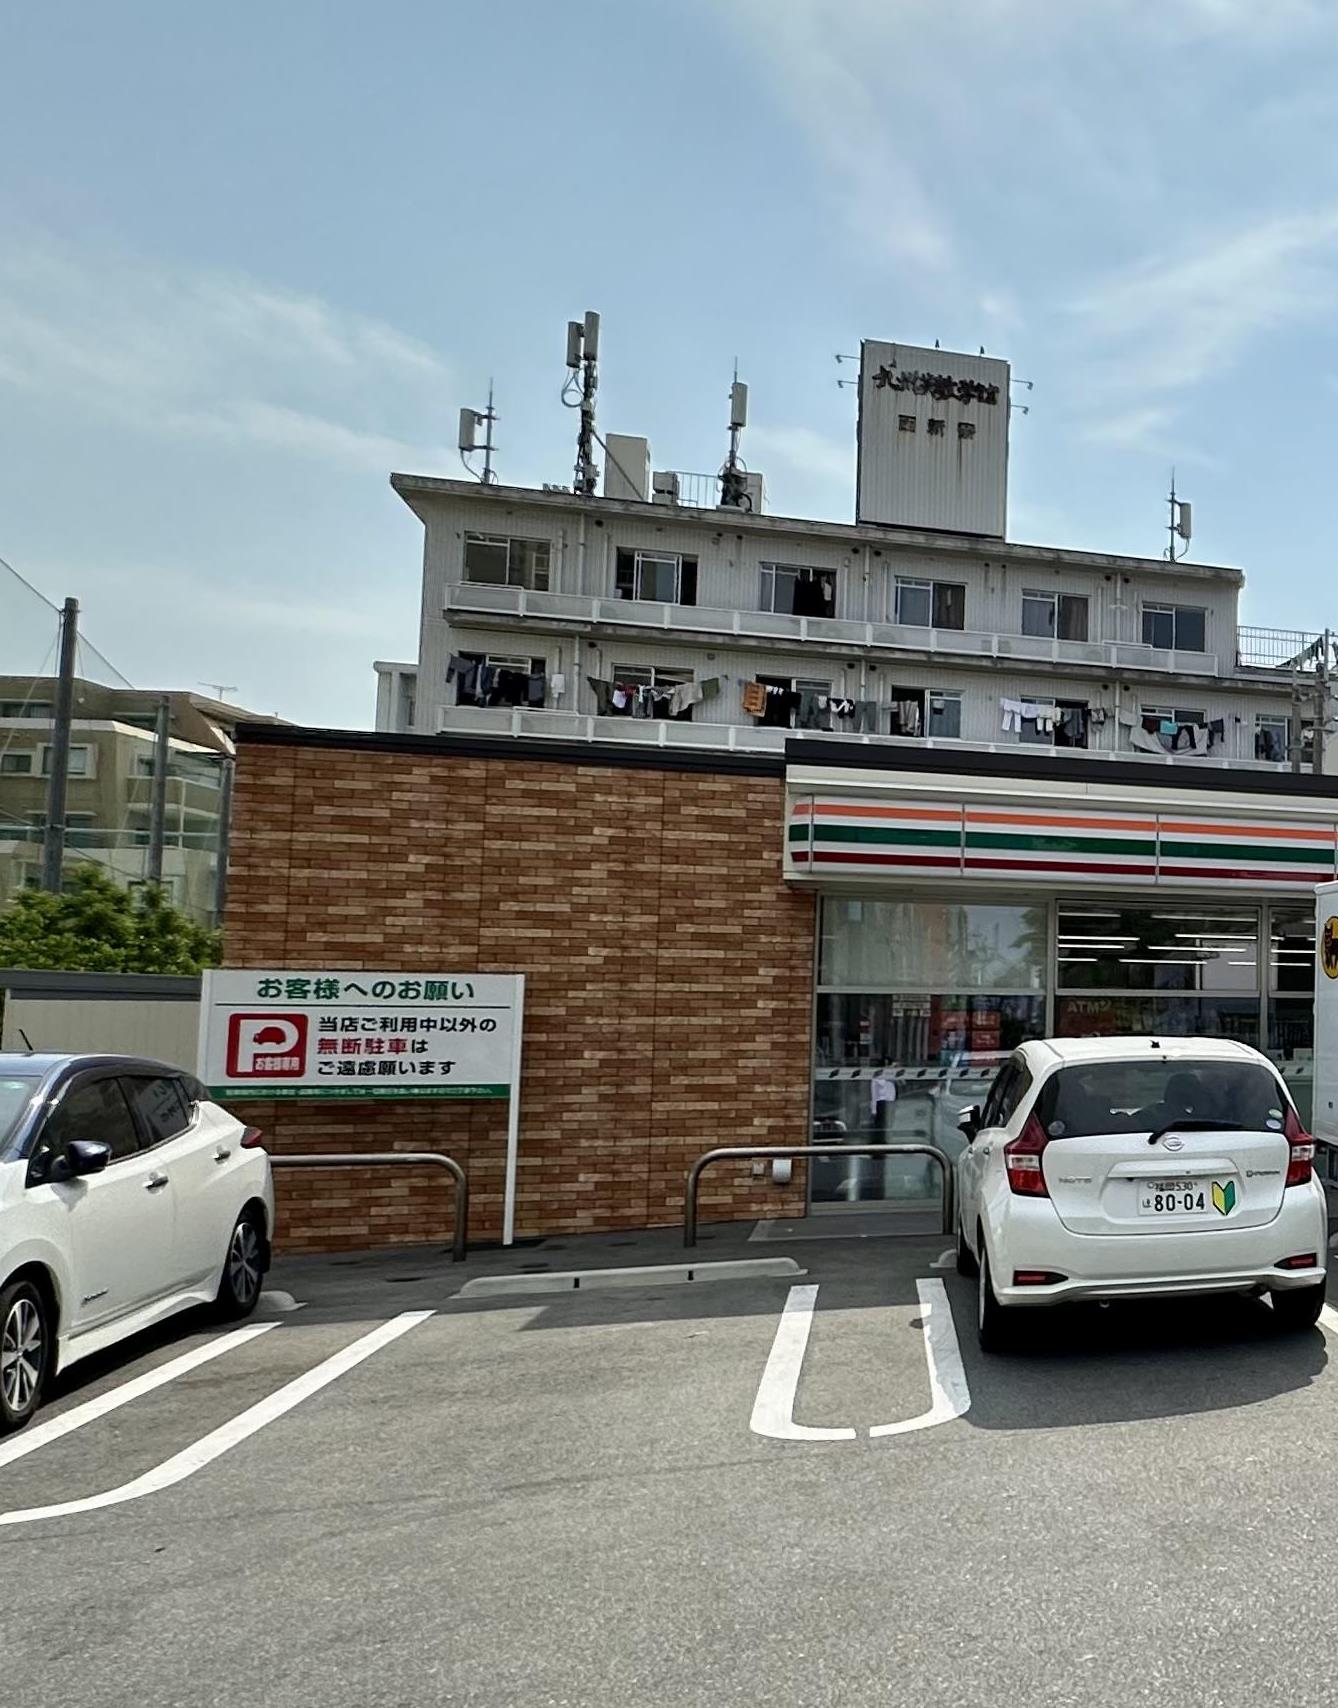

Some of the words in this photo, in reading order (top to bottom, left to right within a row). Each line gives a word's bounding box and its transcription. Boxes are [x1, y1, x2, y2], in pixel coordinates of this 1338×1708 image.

[256, 977, 475, 1001] お客様へのお願い
[318, 1016, 497, 1033] 当店ご利用中以外の
[317, 1038, 429, 1055] 無断駐車は
[317, 1060, 457, 1077] ご遠慮願います
[1154, 1192, 1205, 1212] 80-04
